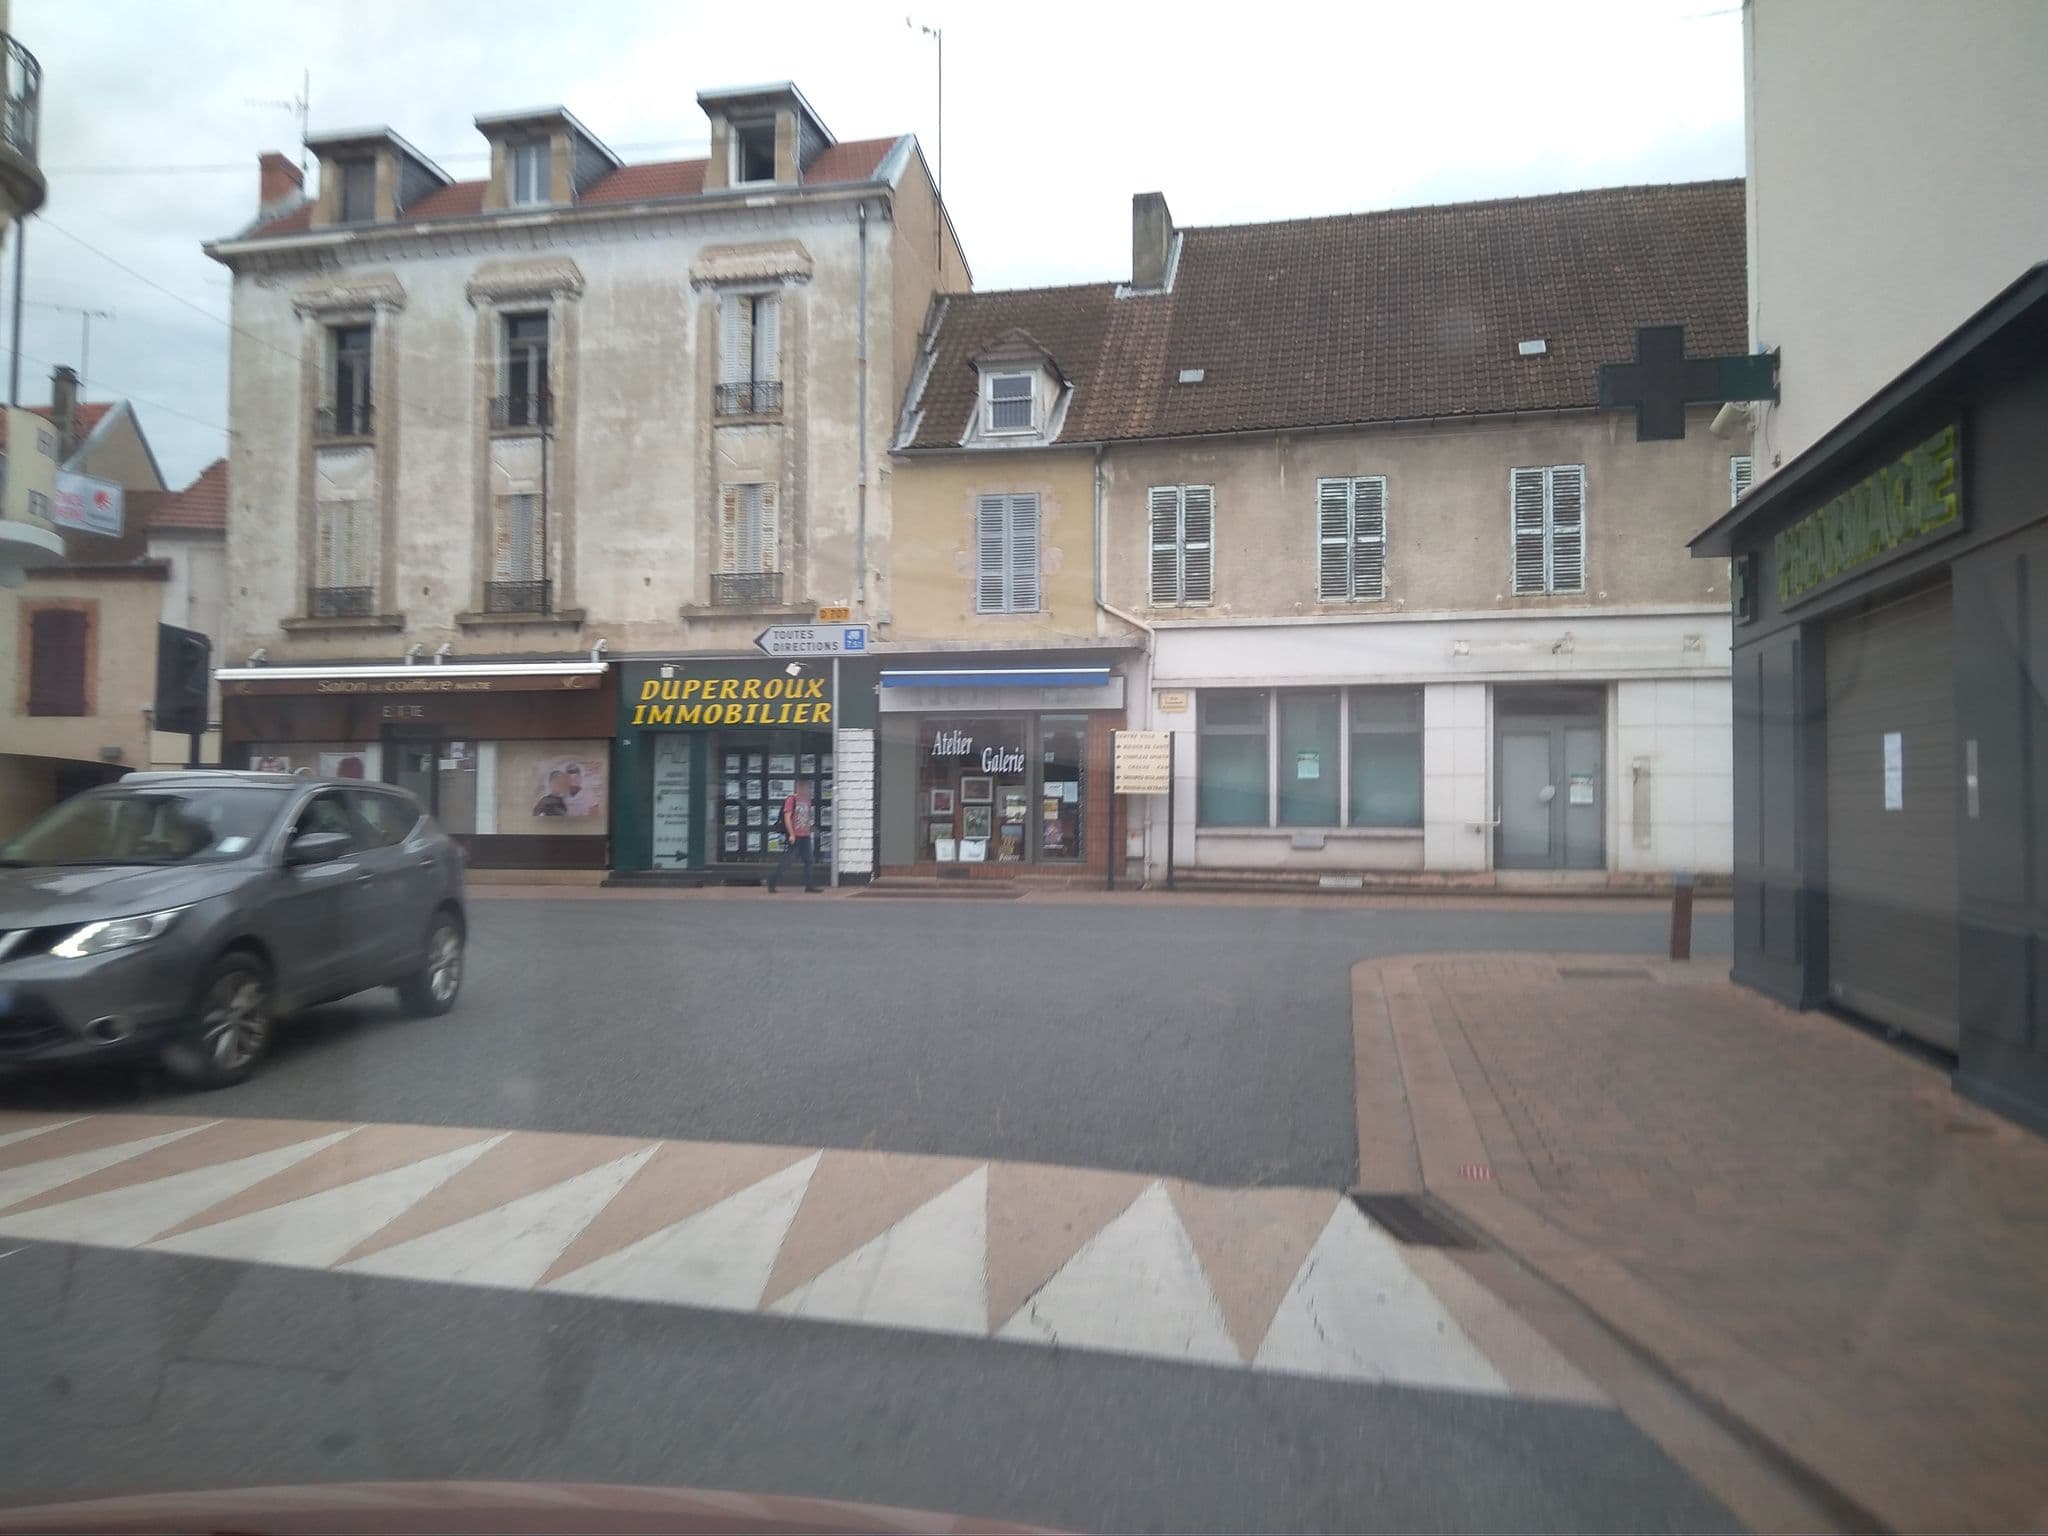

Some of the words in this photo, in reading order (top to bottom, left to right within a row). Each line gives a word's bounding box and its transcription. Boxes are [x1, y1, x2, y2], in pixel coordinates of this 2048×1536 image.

[773, 630, 814, 639] TOUTES
[773, 641, 840, 652] DIRECTIONS
[317, 680, 368, 693] Salon
[640, 678, 825, 700] DUPERROUX
[631, 702, 832, 725] IMMOBILIER
[931, 729, 974, 756] Atelier
[981, 746, 1025, 773] Galerie
